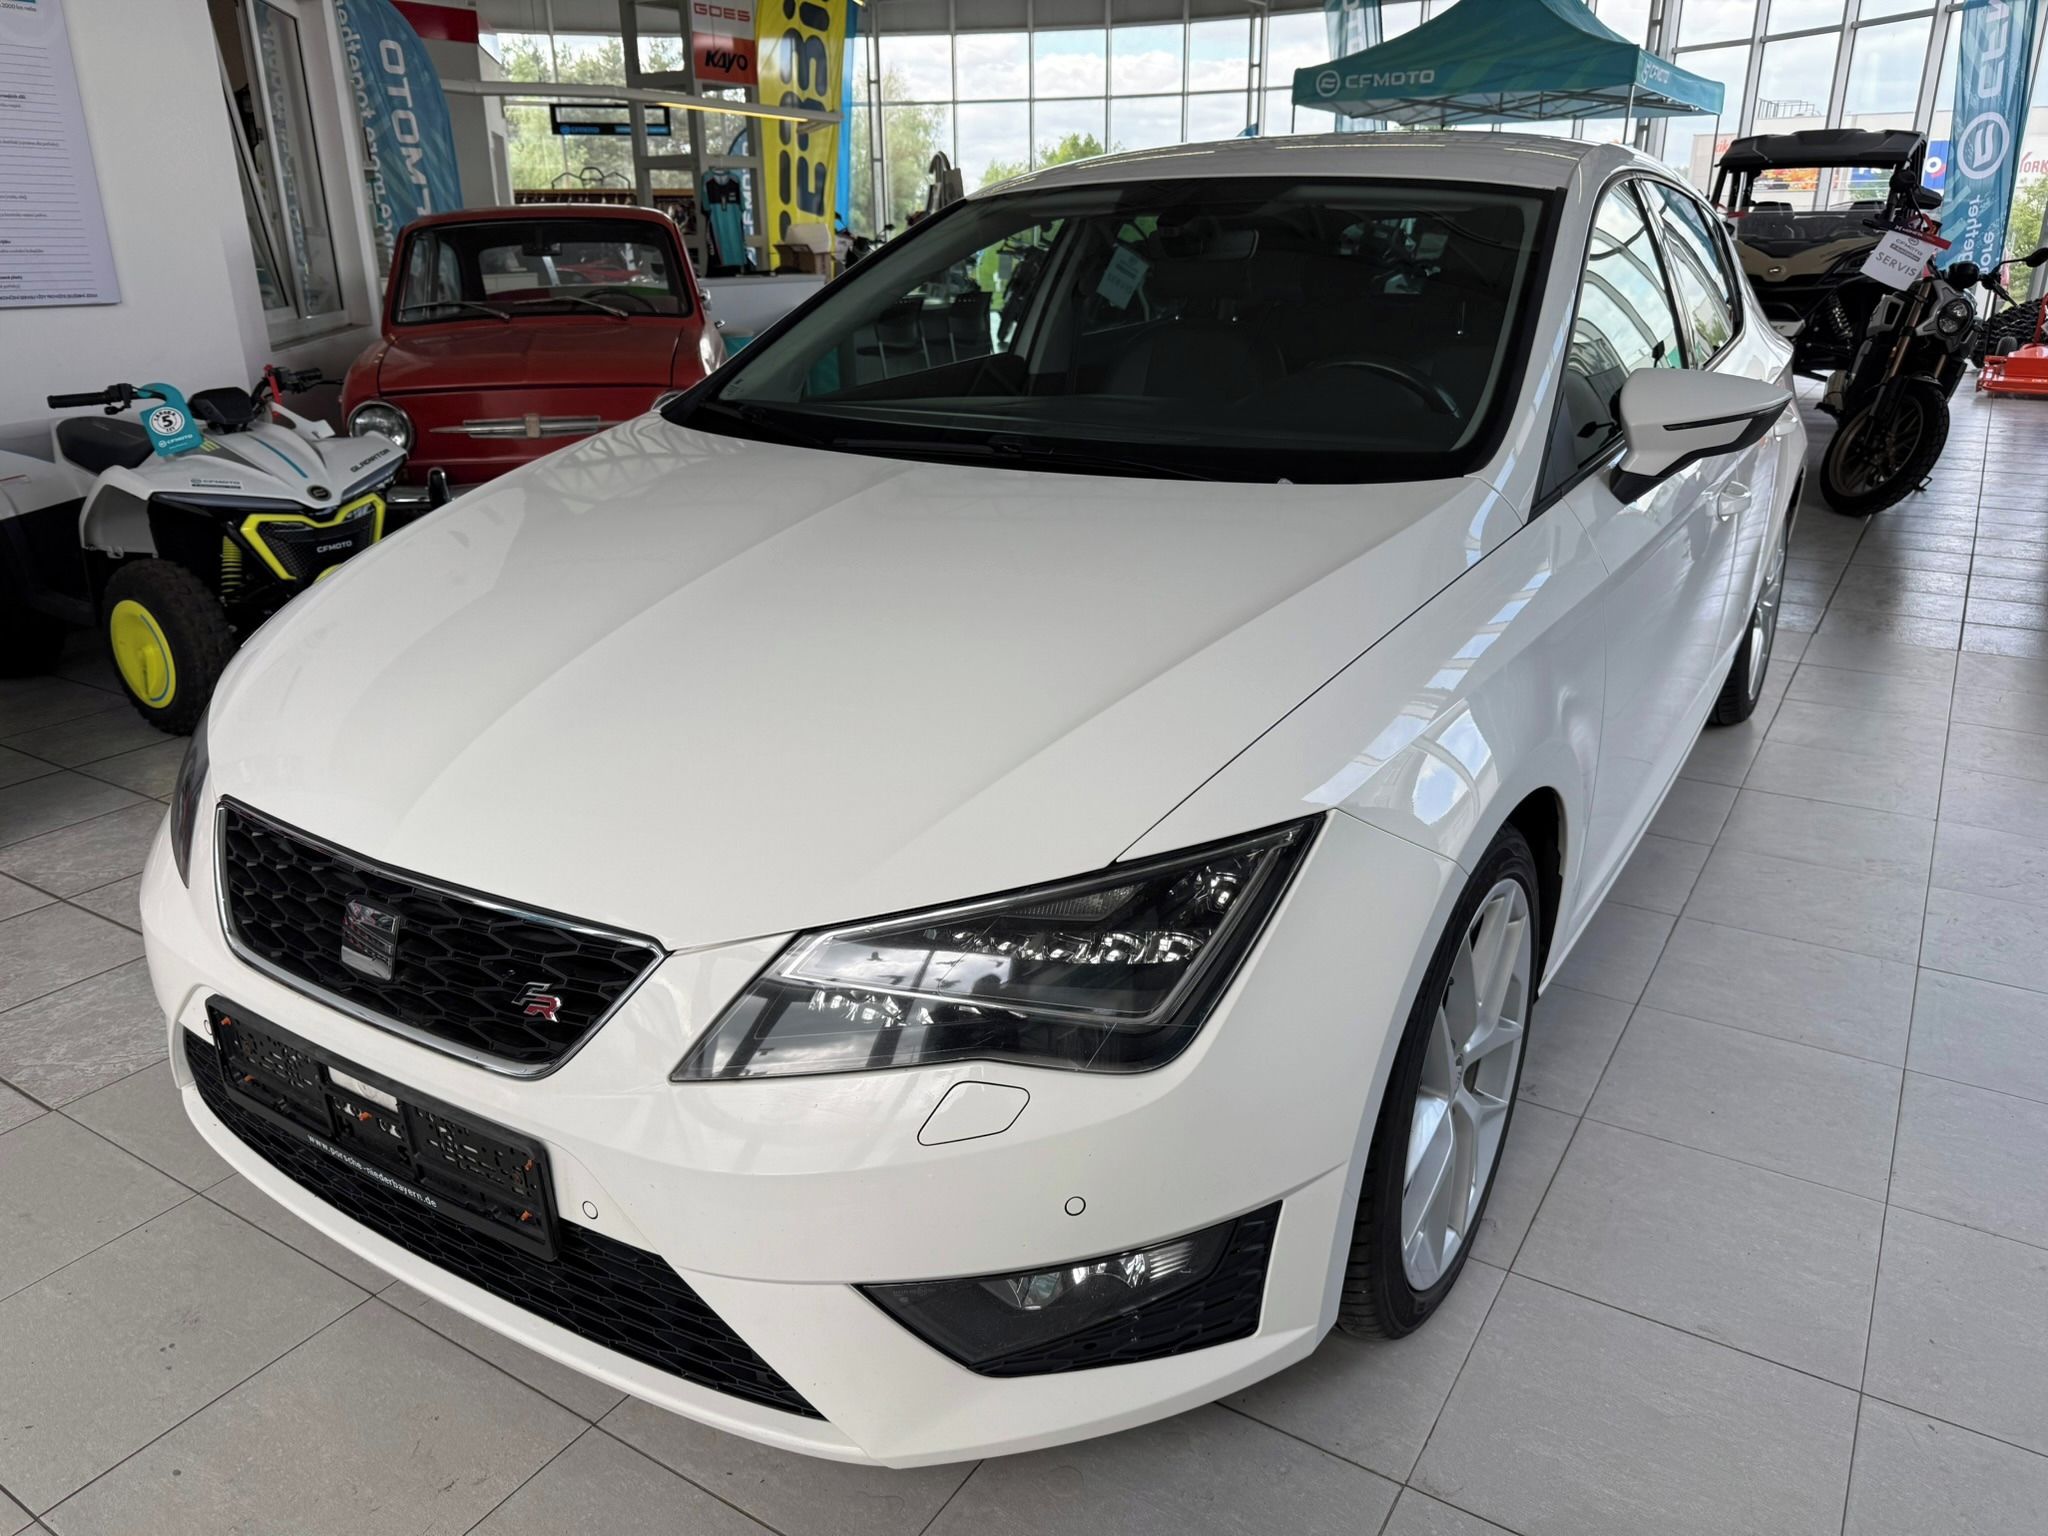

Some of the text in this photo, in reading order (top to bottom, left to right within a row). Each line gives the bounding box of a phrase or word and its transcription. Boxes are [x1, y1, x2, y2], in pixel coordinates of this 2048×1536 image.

[694, 3, 750, 22] GOES
[705, 48, 748, 73] KAYO
[1345, 70, 1435, 88] CFMOTO
[1875, 251, 1918, 277] SERVIS
[161, 415, 174, 428] 5
[350, 448, 390, 473] GLADIATOR
[316, 540, 353, 553] CFMOTO
[511, 981, 562, 1023] FR
